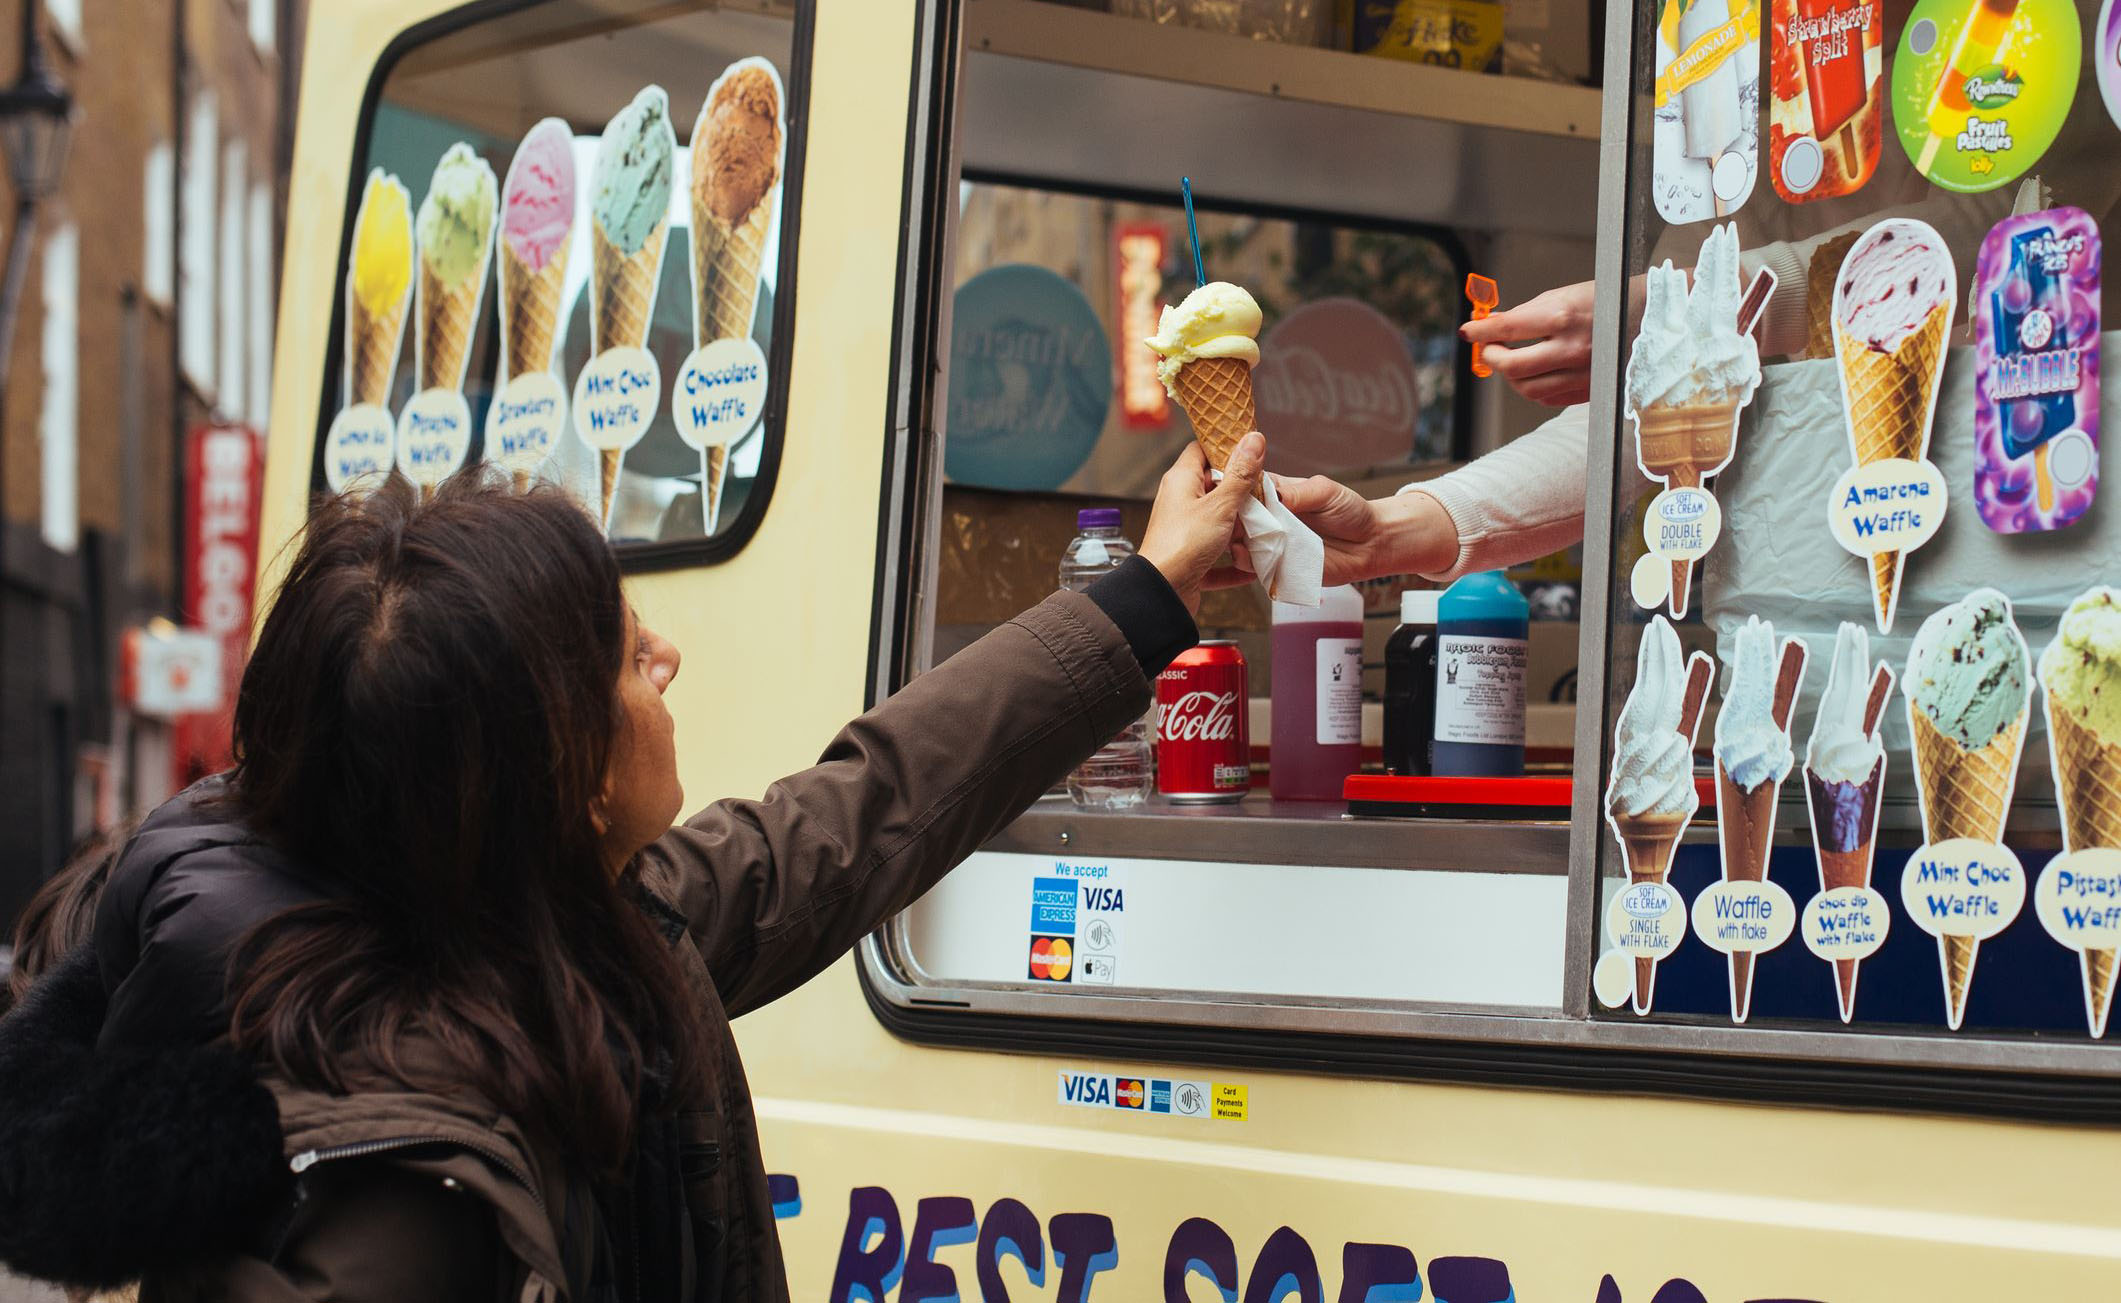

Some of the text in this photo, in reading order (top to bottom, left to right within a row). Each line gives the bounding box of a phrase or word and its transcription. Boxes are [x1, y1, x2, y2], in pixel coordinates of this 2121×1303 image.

[1787, 4, 1873, 46] Strawberry
[1673, 26, 1737, 77] LEMONADE
[1812, 31, 1848, 66] Split
[1967, 117, 2008, 138] Fruit
[619, 369, 651, 395] Choc
[685, 362, 758, 396] Chocolate
[591, 404, 639, 432] Waffle
[692, 397, 745, 429] Waffle
[1676, 494, 1692, 504] SOFT
[1843, 481, 1930, 509] Amarena
[1662, 503, 1704, 515] ICE CREAM
[1661, 524, 1702, 539] DOUBLE
[1852, 510, 1921, 538] Waffle
[1660, 538, 1703, 550] WITH FLAKE
[1055, 862, 1108, 879] We accept
[1917, 861, 2011, 887] Mint Choc
[1639, 888, 1655, 898] SOFT
[2057, 870, 2121, 898] Pistas
[1033, 890, 1075, 906] AMERICAN
[1082, 886, 1124, 912] VISA
[1625, 898, 1667, 909] ICE CREAM
[1714, 895, 1772, 919] Waffle
[1818, 895, 1868, 910] choc dip
[1926, 894, 1999, 918] Waffle
[1040, 906, 1076, 922] EXPRESS
[1818, 912, 1871, 933] Waffle
[1630, 920, 1660, 934] SINGLE
[1717, 923, 1767, 940] with flake
[1620, 934, 1669, 948] WITH FLAKE
[1816, 931, 1876, 947] with flake
[1094, 959, 1113, 981] Pay
[1061, 1074, 1110, 1105] VISA
[1223, 1087, 1237, 1096] Card
[1216, 1098, 1243, 1108] Payments
[1217, 1109, 1242, 1118] Welcome
